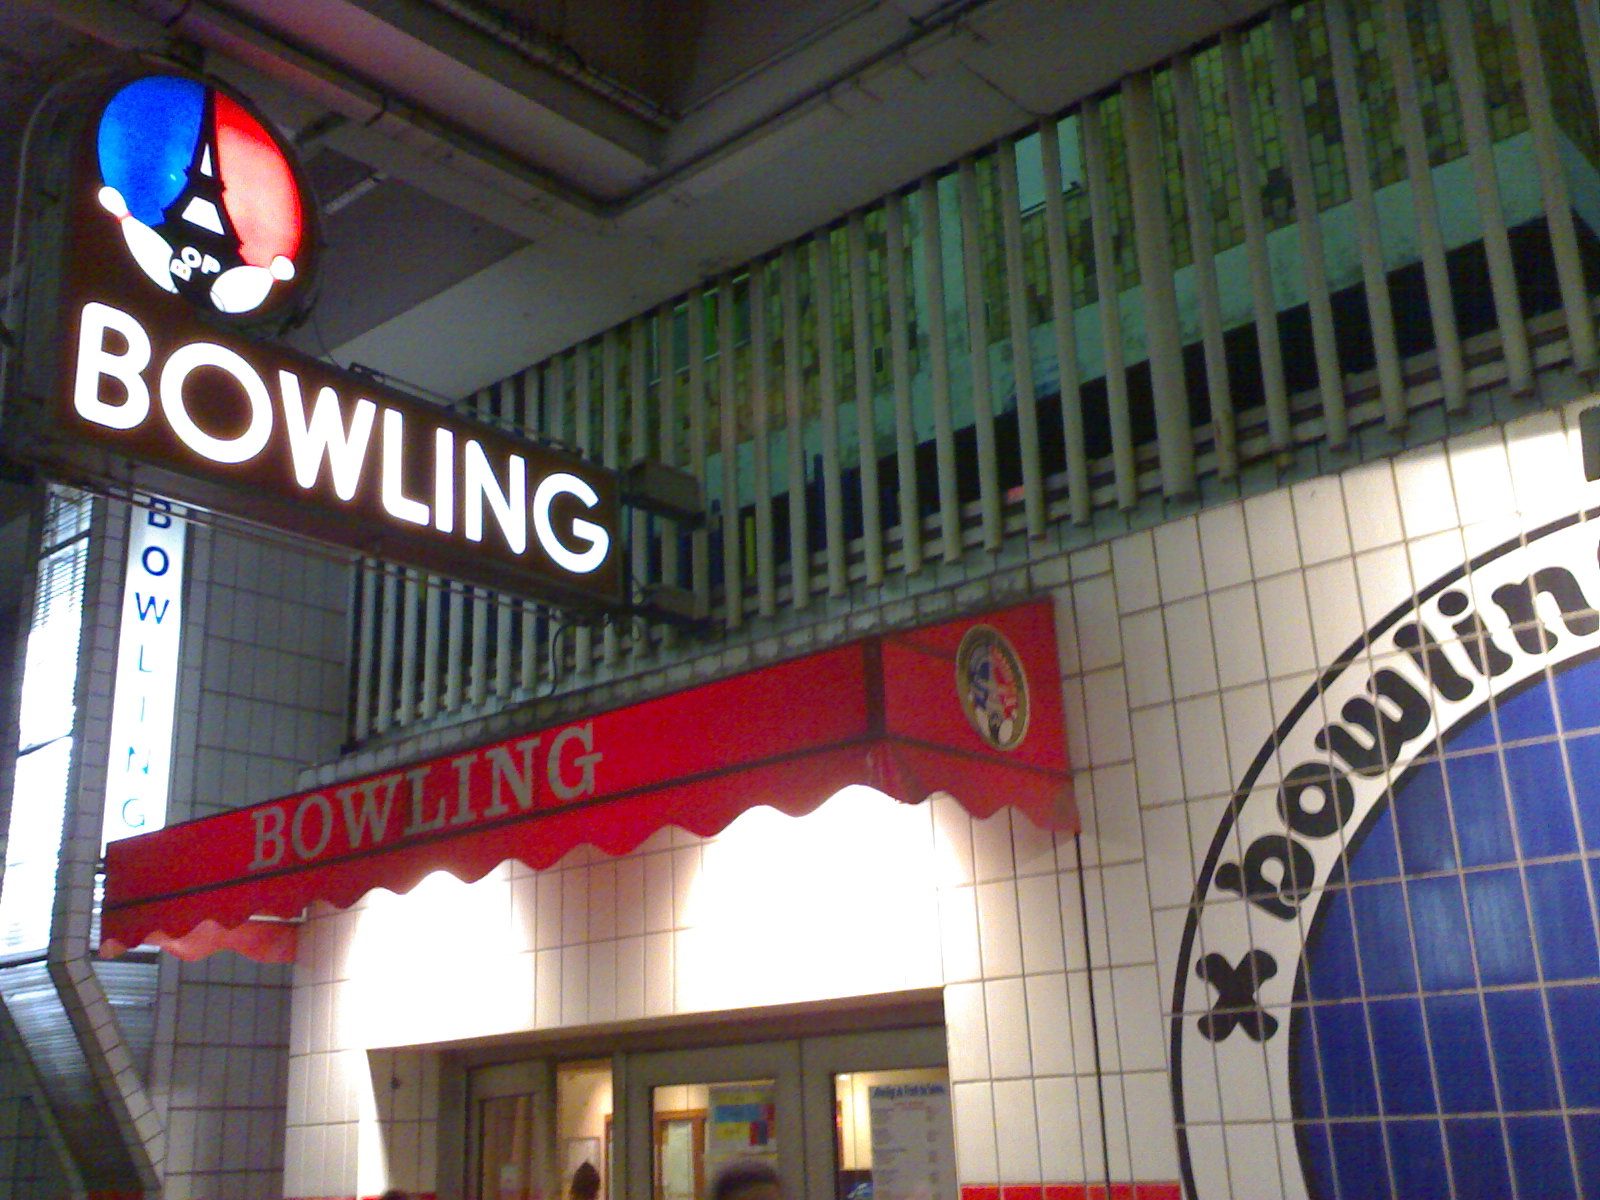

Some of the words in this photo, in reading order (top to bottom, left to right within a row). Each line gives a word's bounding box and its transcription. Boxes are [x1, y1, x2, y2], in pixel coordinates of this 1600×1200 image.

[170, 246, 220, 281] BOP
[74, 301, 610, 573] BOWLING
[248, 722, 603, 871] BOWLING
[1215, 539, 1600, 922] bowlin
